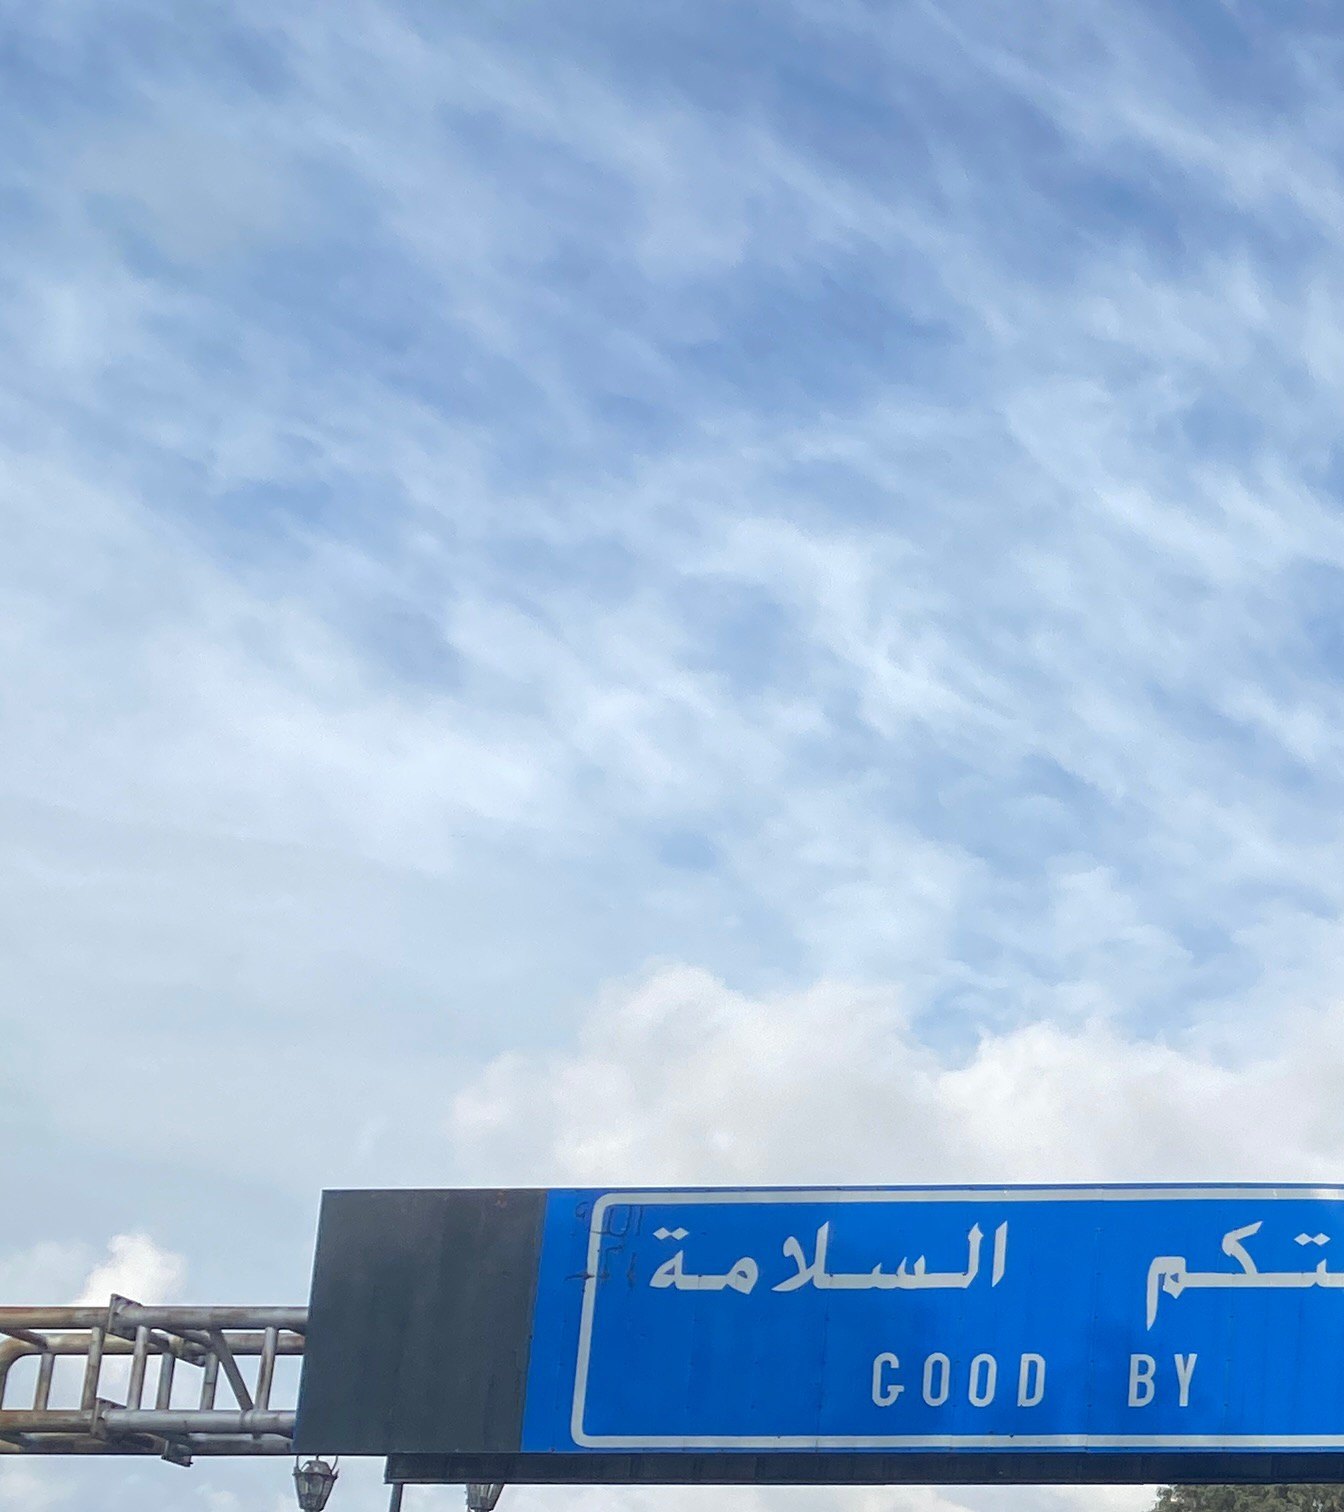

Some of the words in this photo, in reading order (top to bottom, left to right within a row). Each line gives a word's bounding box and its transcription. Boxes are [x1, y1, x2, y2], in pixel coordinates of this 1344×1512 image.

[649, 1219, 1009, 1295] السلامة
[871, 1351, 1047, 1408] GOOD
[1127, 1352, 1199, 1408] BY
